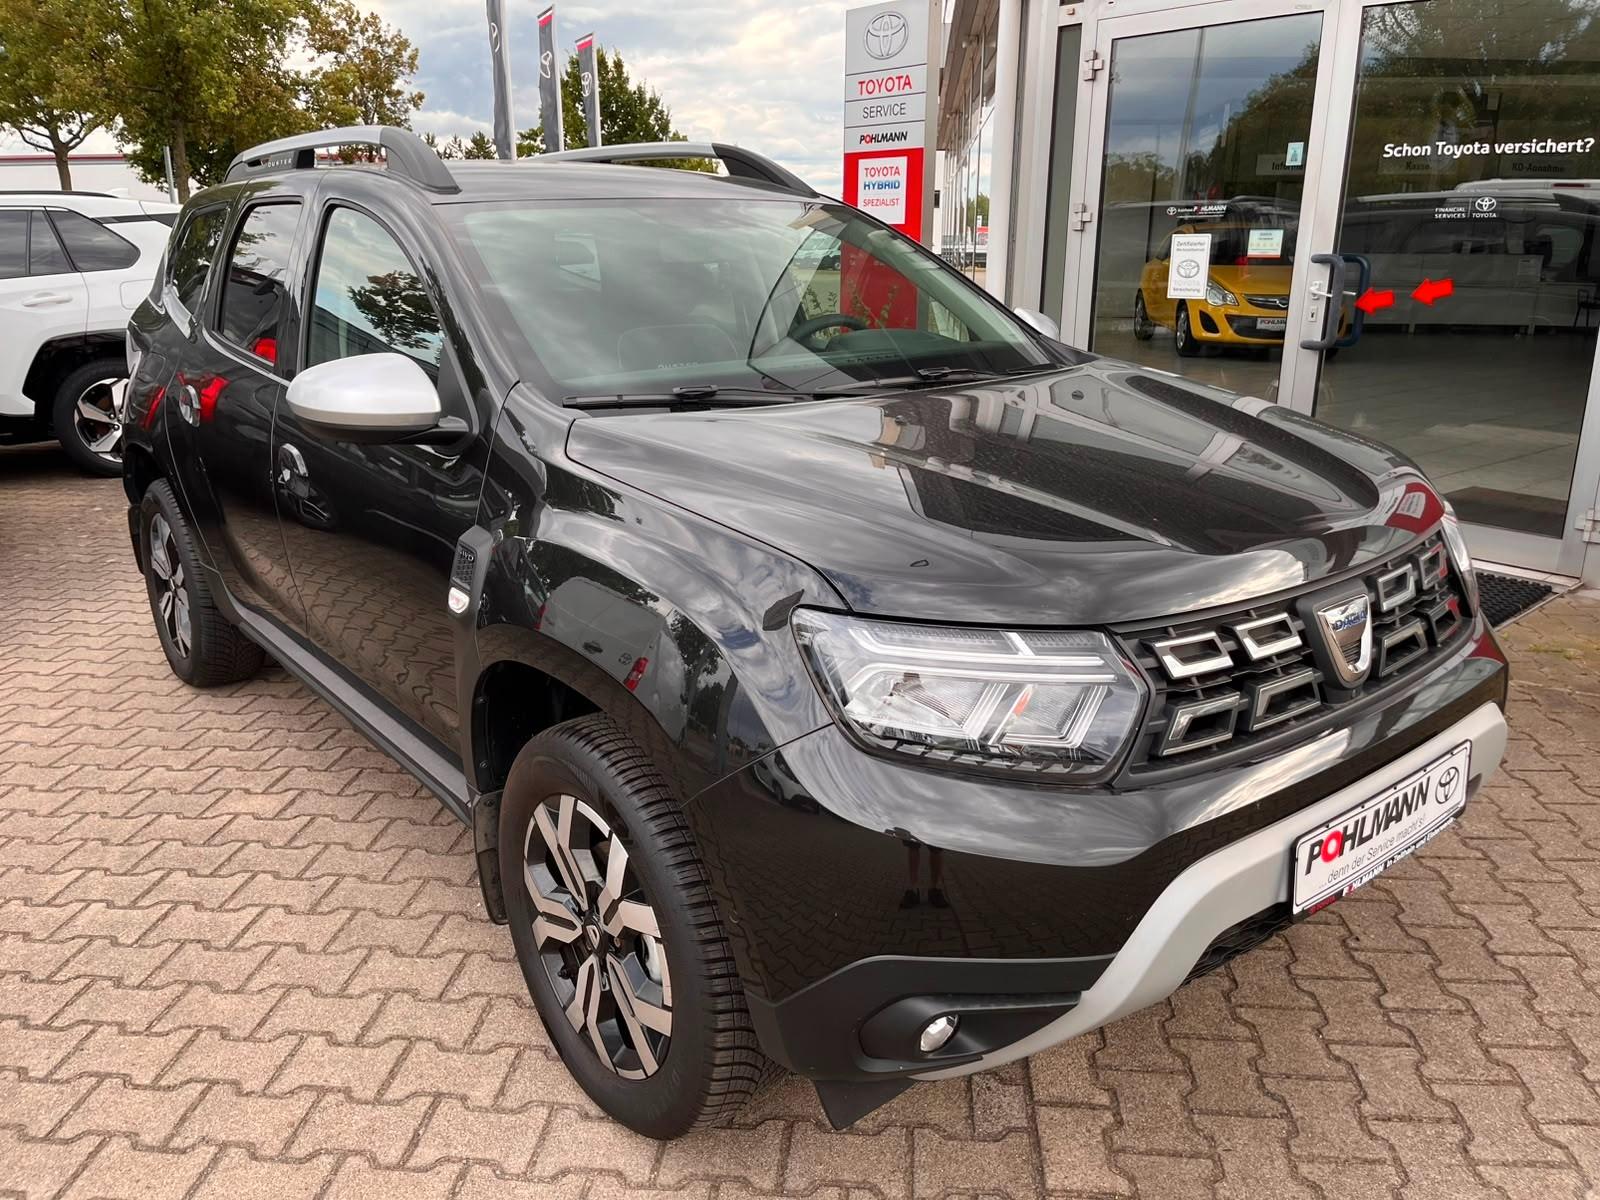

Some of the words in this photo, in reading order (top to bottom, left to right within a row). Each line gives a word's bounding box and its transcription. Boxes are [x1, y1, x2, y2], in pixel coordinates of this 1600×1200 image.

[858, 74, 912, 96] TOYOTA
[862, 102, 906, 119] SERVICE
[859, 131, 908, 145] POHLMANN
[1383, 143, 1431, 158] Schon
[1435, 141, 1490, 159] Toyota
[1495, 138, 1595, 155] versichert?
[864, 166, 901, 178] TOYOTA
[863, 180, 901, 191] HYBRID
[863, 198, 900, 208] SPEZIALIST
[1334, 610, 1367, 631] DACIA
[1305, 776, 1431, 876] POHLMANN
[1351, 854, 1366, 870] der
[1367, 836, 1396, 861] Service
